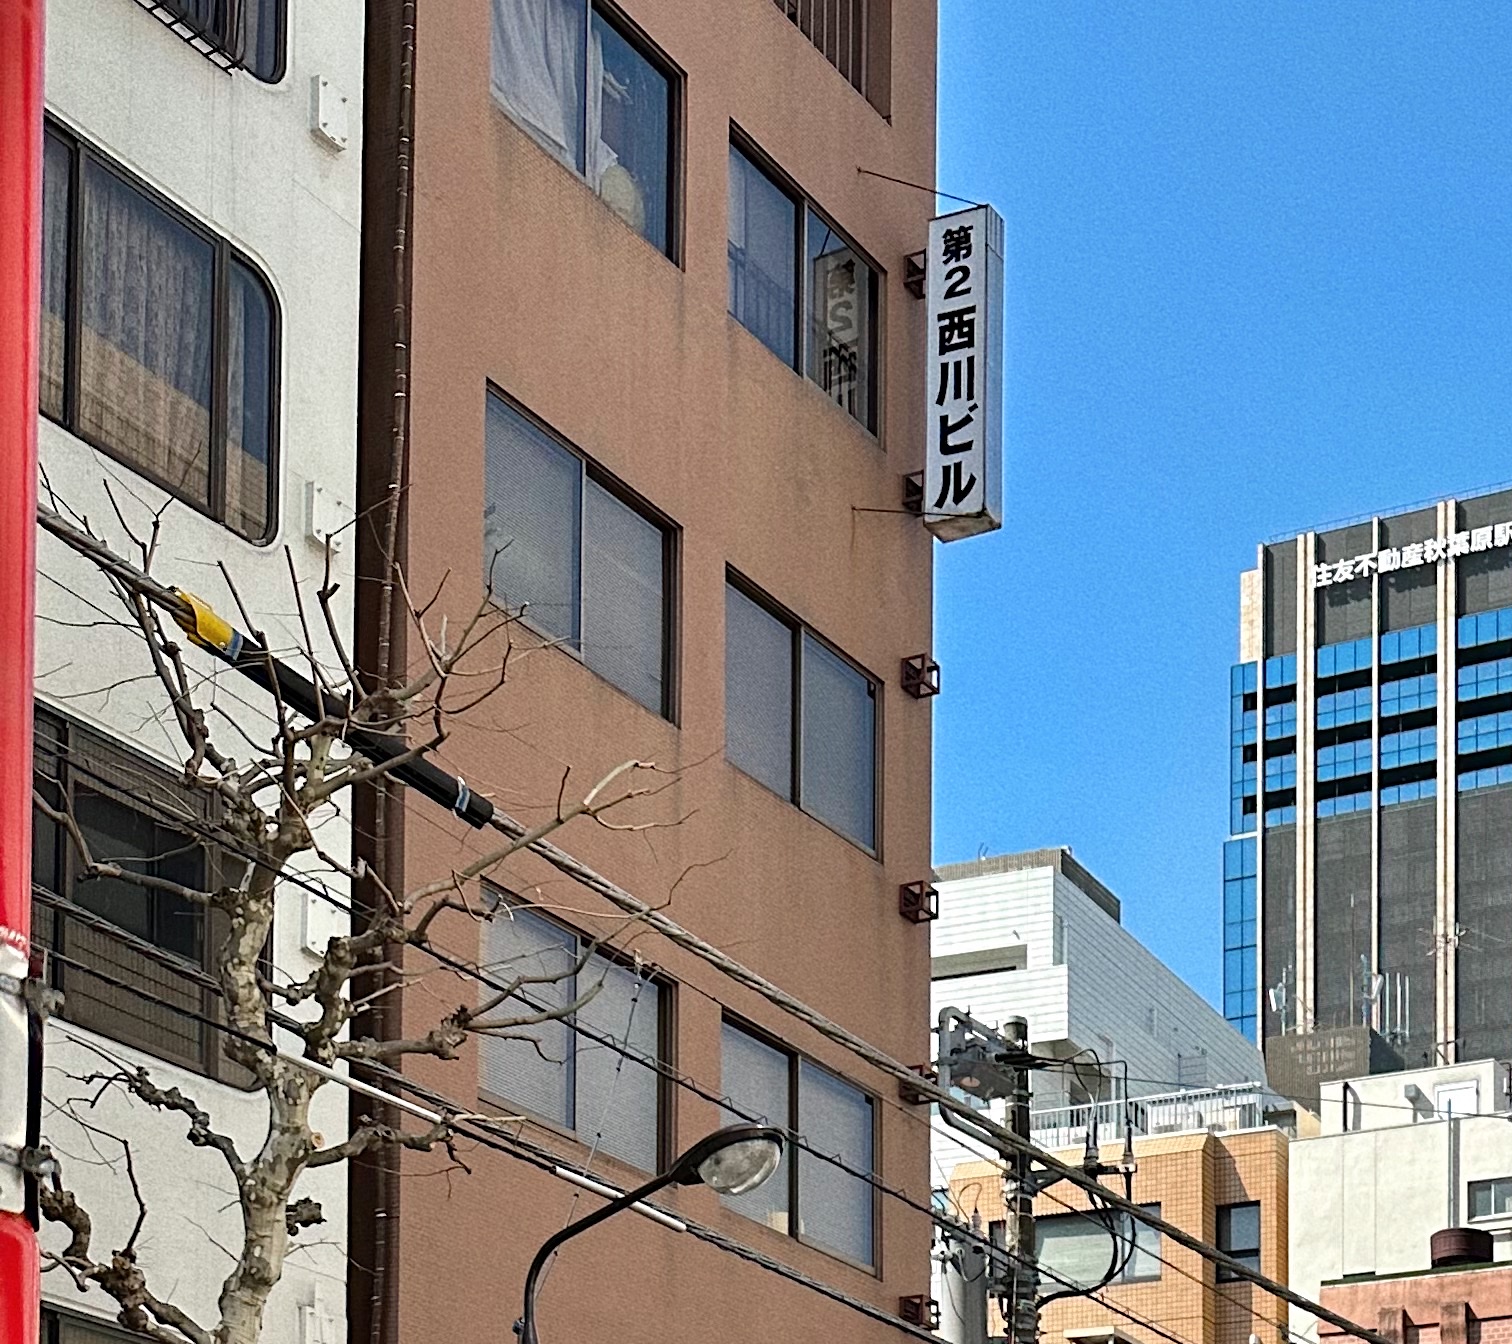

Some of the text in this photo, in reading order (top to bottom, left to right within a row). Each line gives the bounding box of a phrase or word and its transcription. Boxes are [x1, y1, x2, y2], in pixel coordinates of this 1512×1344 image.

[933, 225, 978, 509] 第2西川ビル
